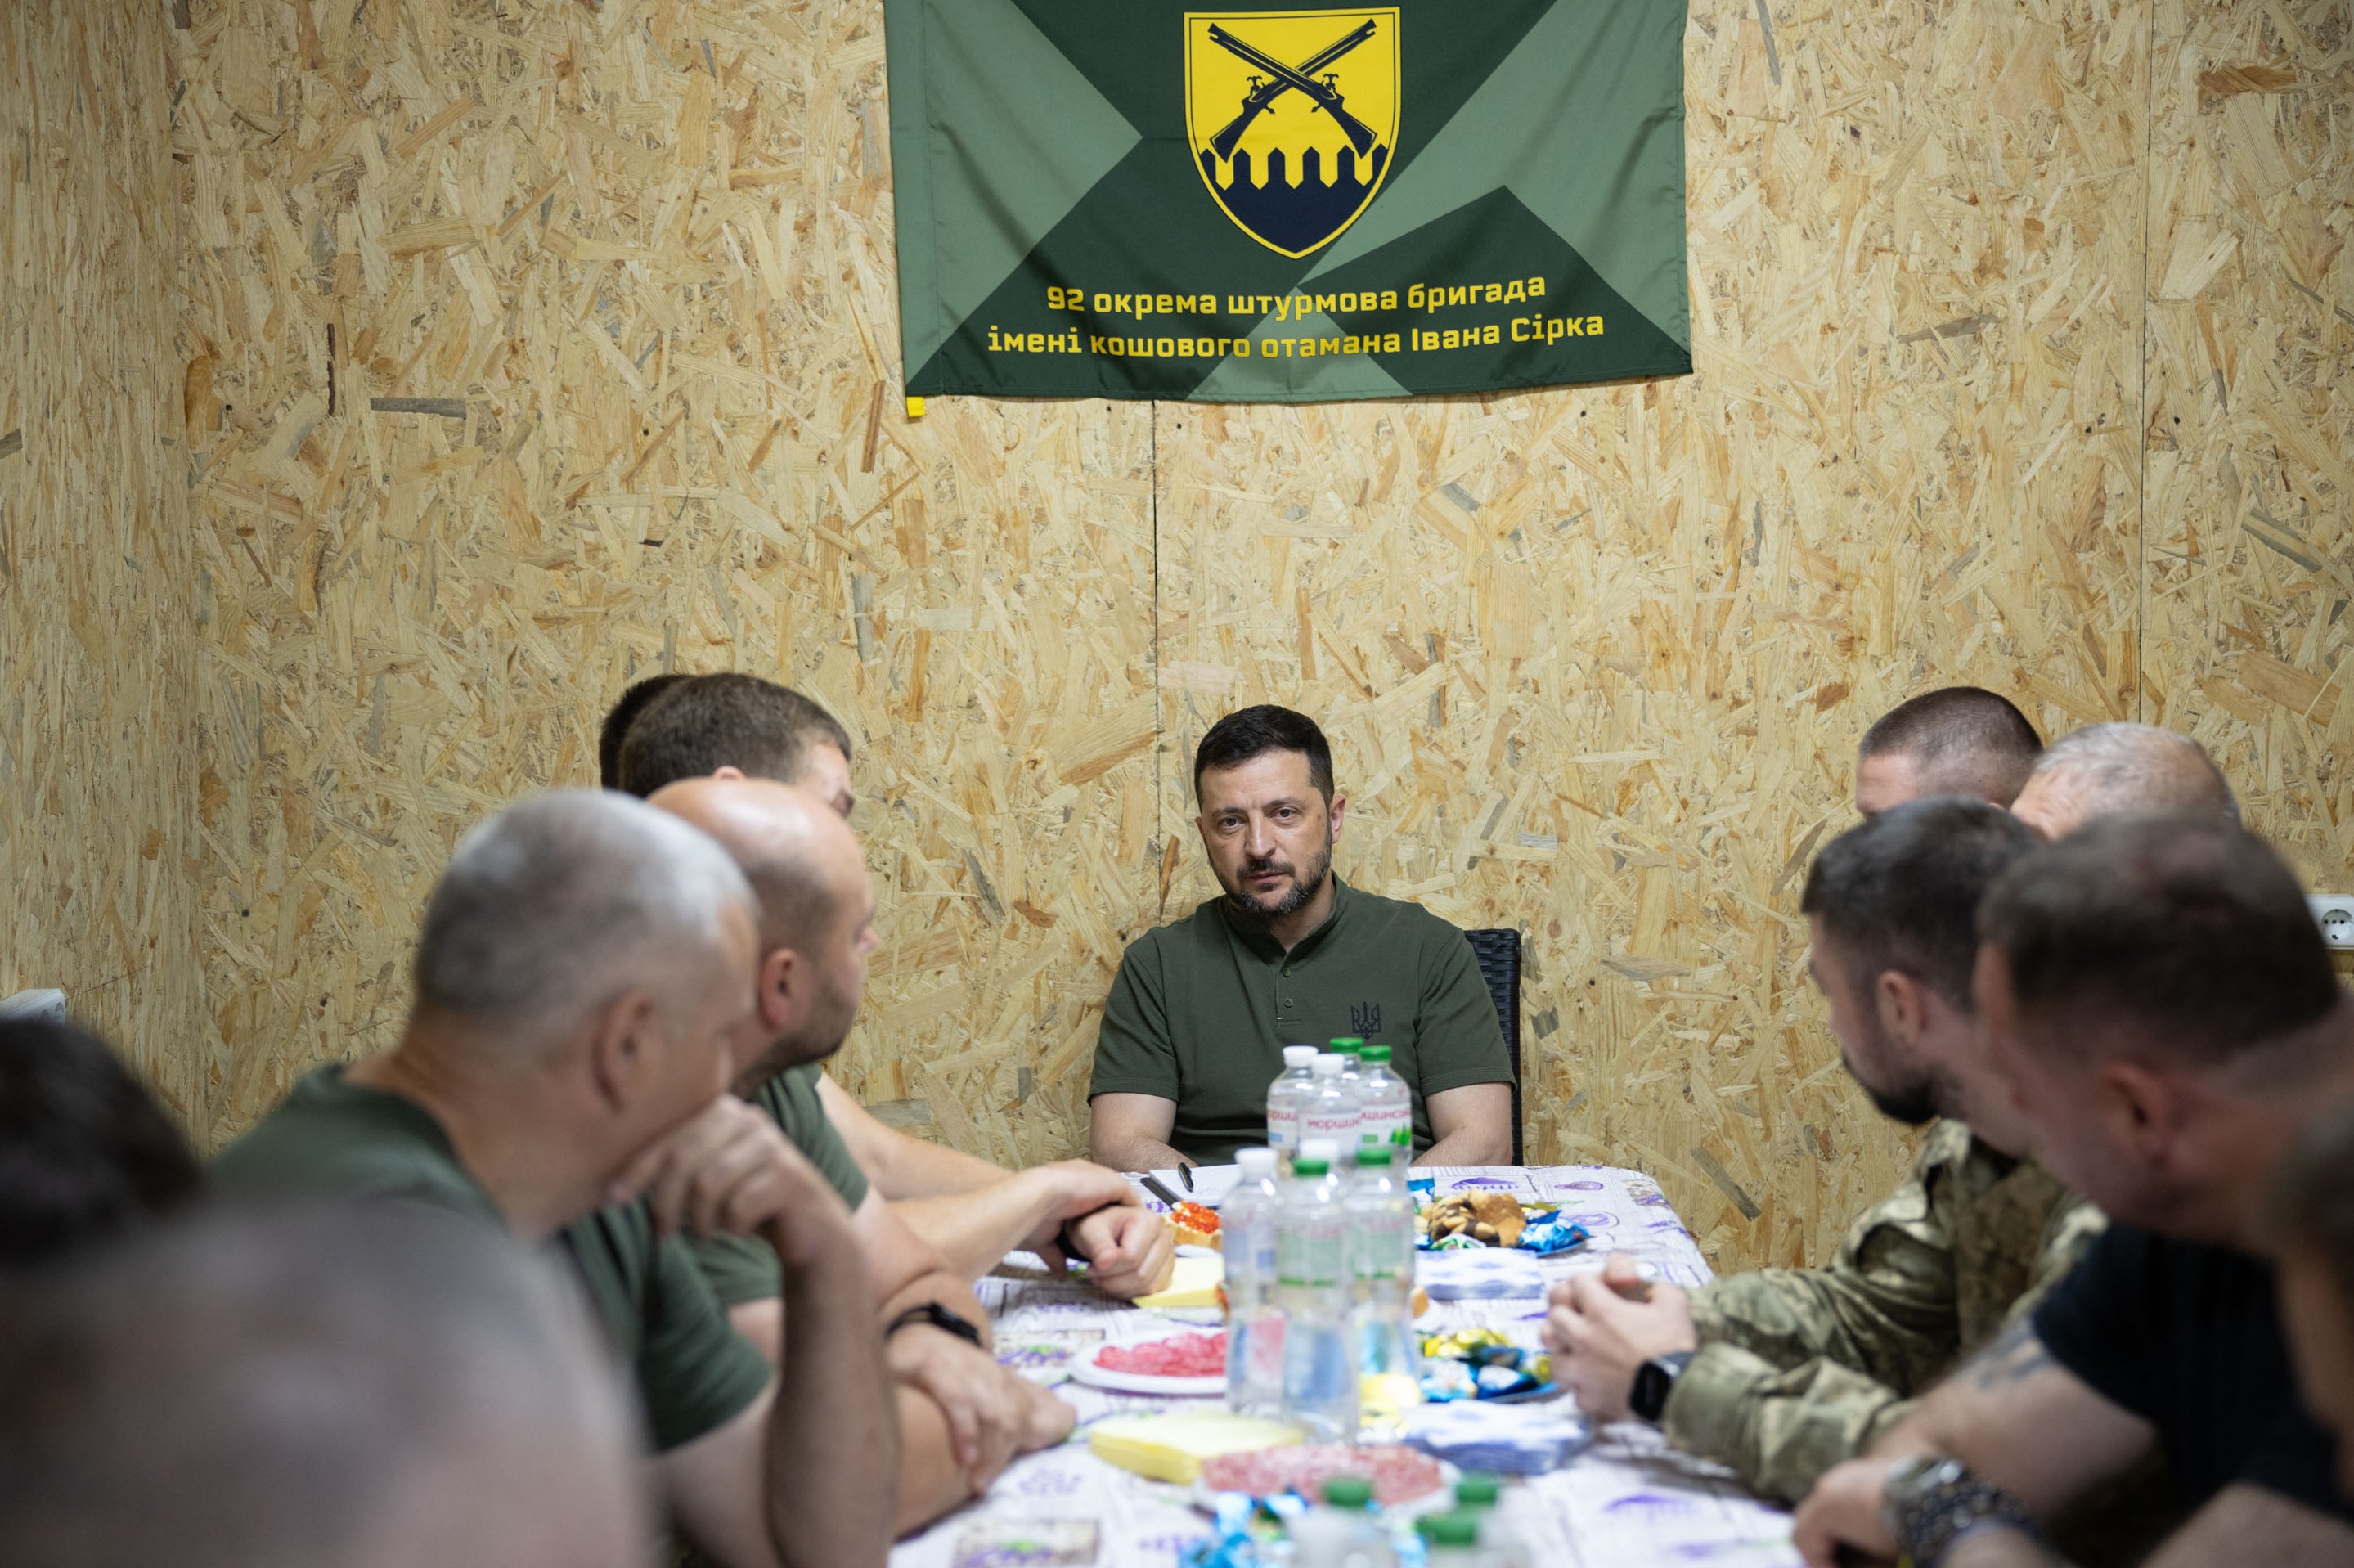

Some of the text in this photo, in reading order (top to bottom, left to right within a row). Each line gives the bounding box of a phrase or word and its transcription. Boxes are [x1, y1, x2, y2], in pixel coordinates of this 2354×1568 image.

[1047, 276, 1546, 322] 92 окрема штурмова бригада
[987, 313, 1604, 358] імені кошового отамана Івана Сірка
